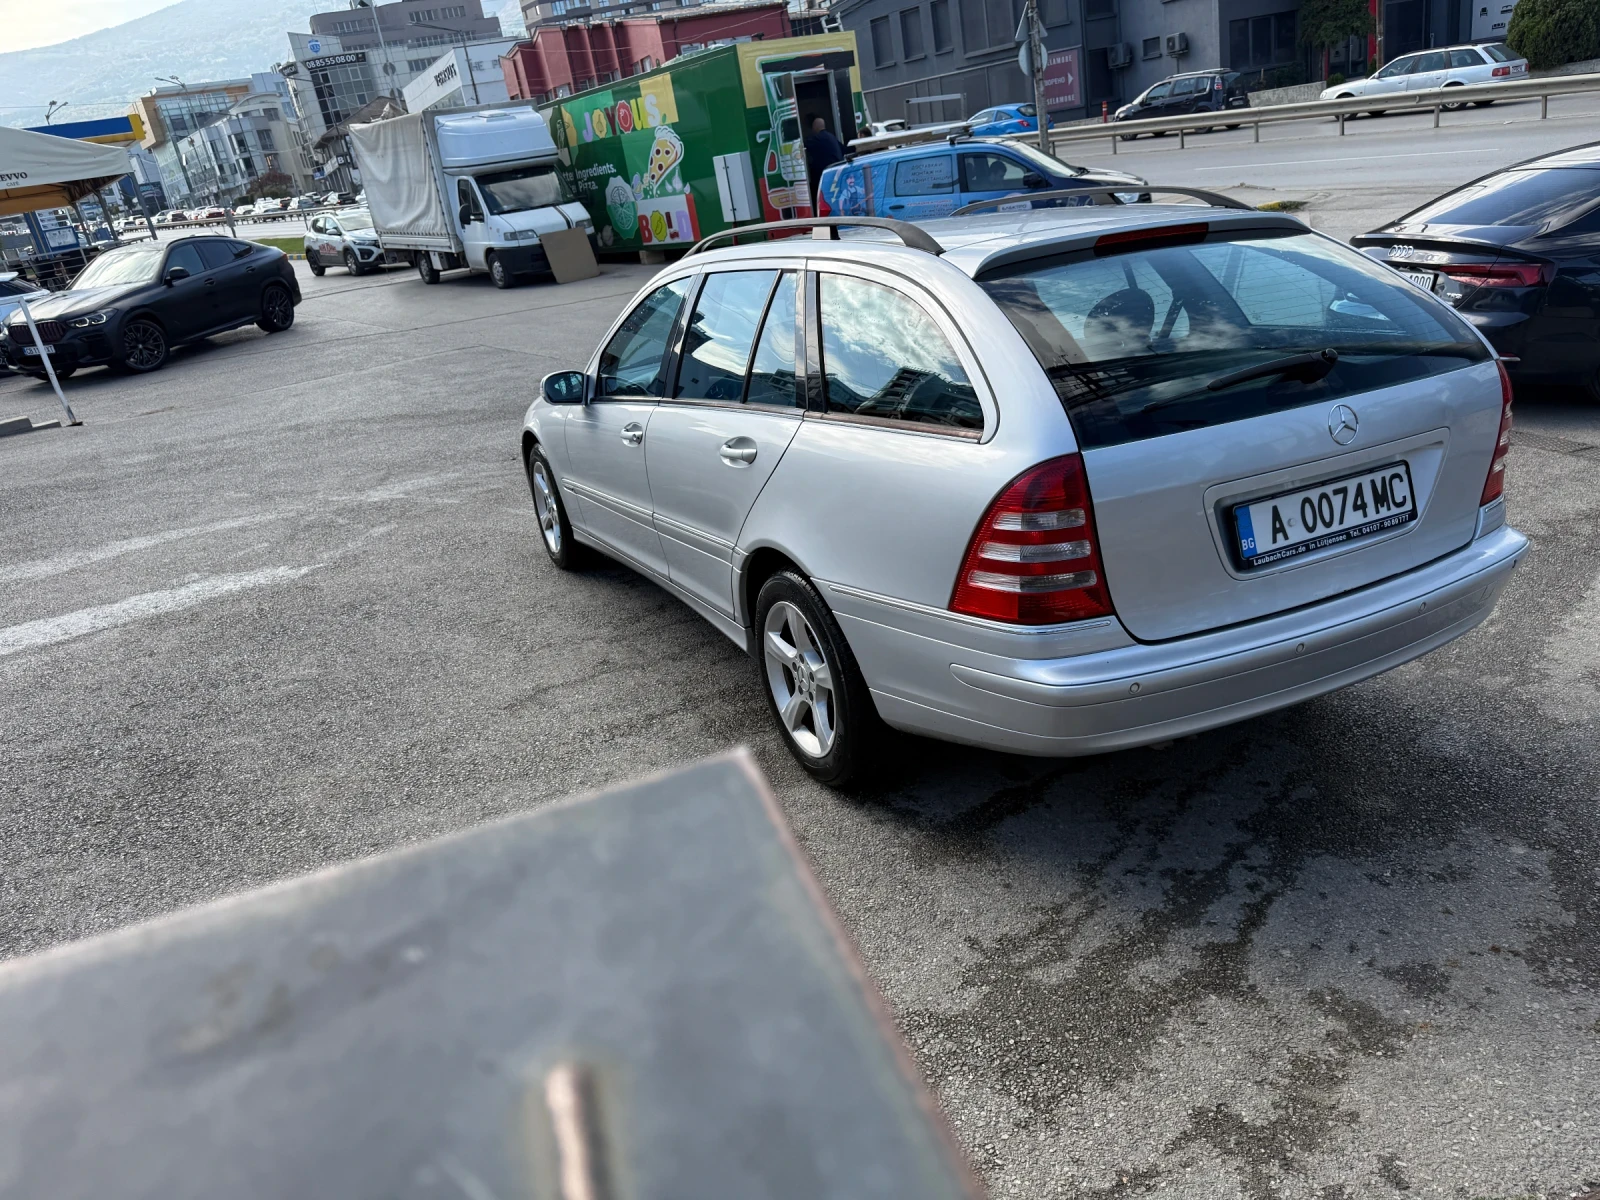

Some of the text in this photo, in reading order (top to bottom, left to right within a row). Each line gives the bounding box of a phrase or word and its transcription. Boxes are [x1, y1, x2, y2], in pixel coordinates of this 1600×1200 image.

[0, 171, 28, 182] EVVO
[575, 162, 617, 181] Ingredients.
[1241, 537, 1255, 551] BG
